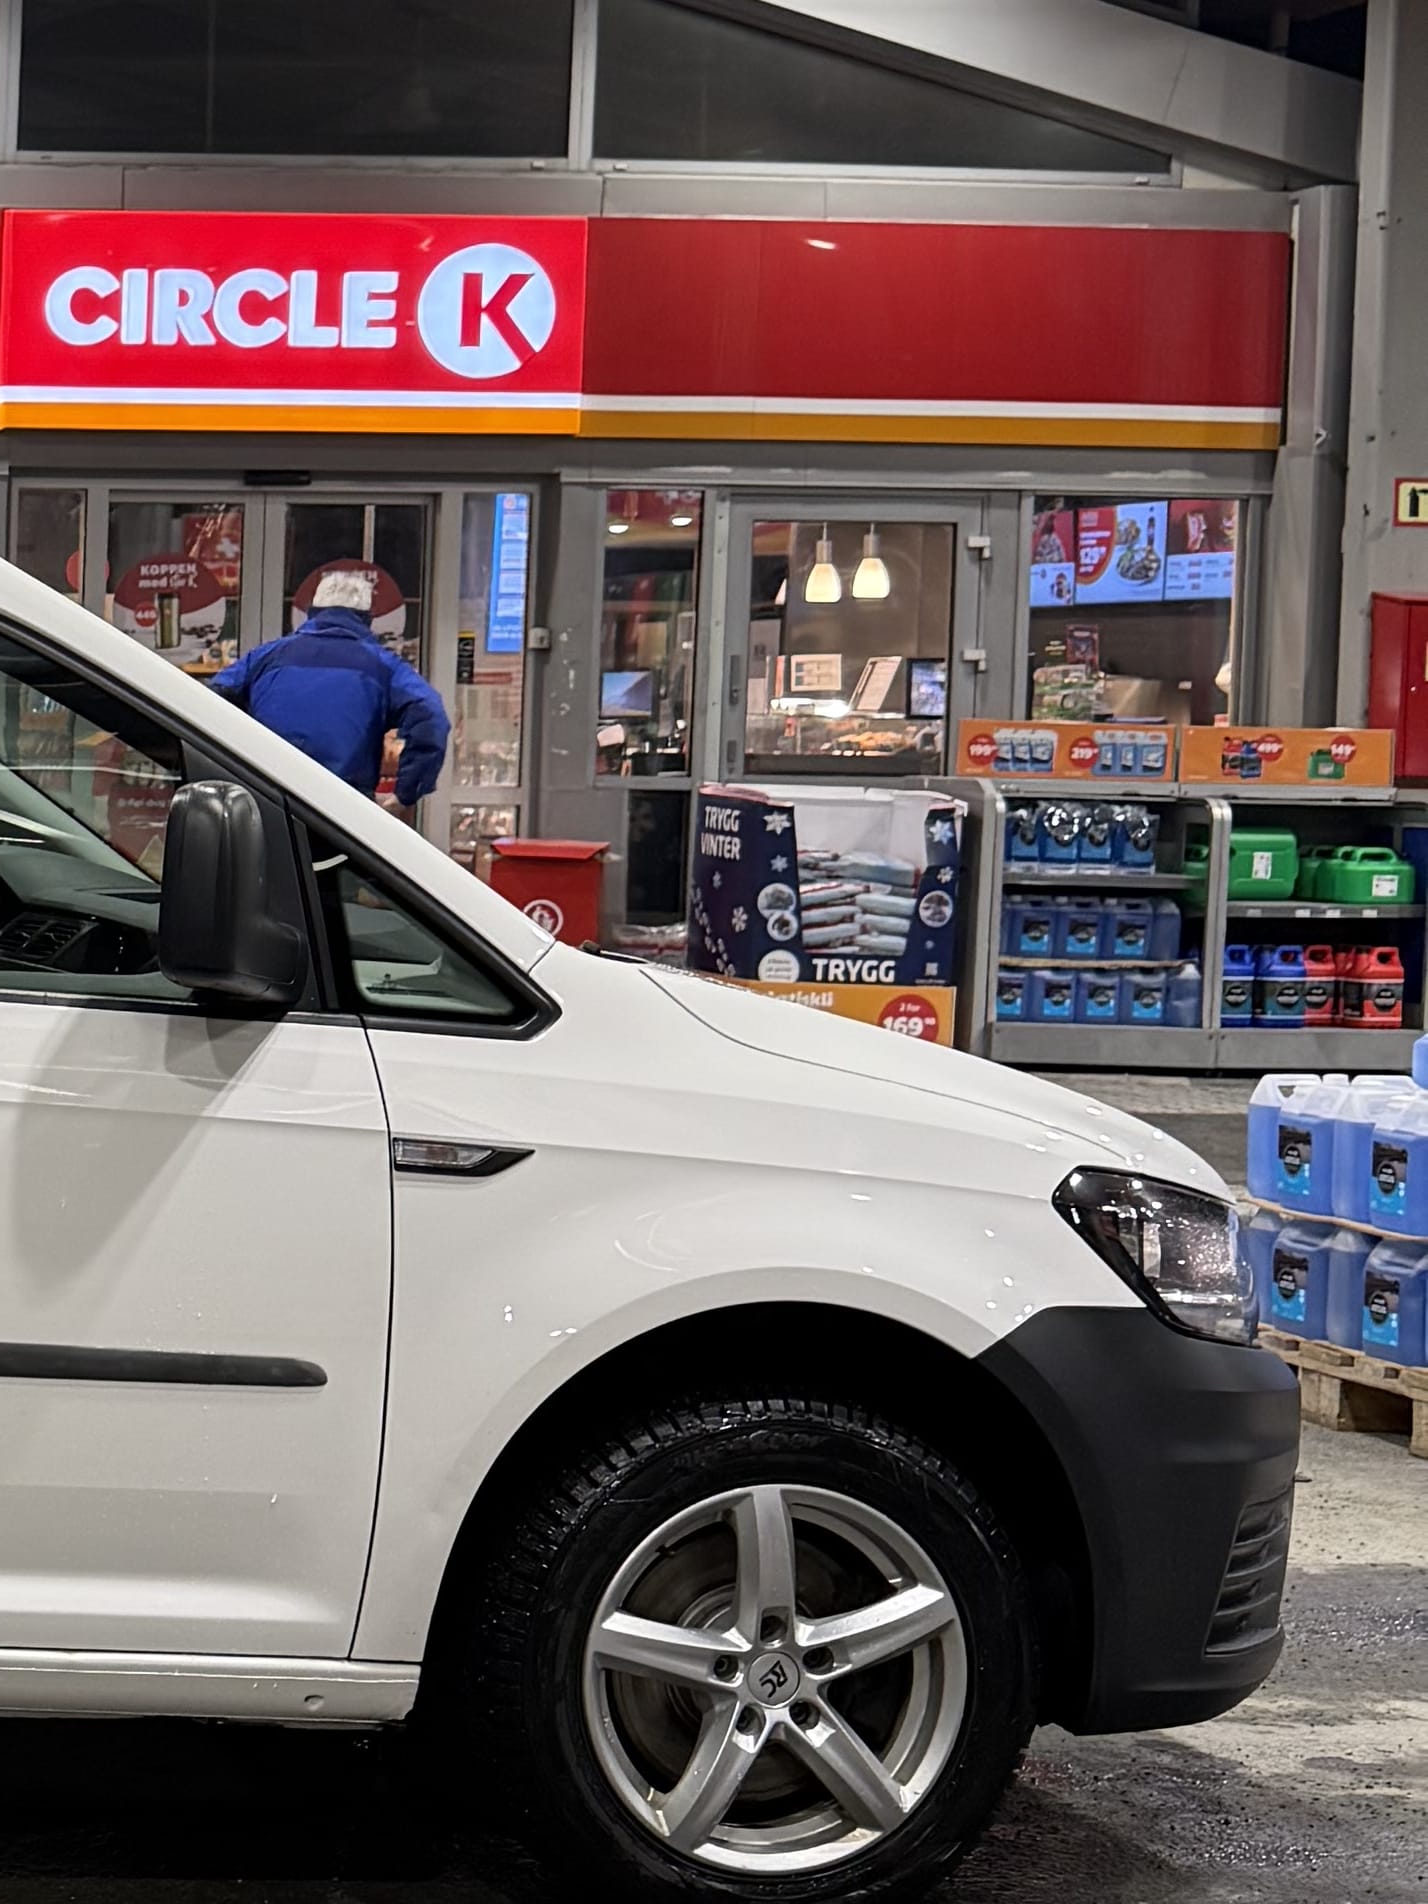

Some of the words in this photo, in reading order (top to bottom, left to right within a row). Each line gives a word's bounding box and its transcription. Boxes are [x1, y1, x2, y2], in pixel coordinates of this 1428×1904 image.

[44, 265, 400, 350] CIRCLE
[704, 805, 741, 832] TRYGG
[701, 833, 741, 860] VINTER
[812, 958, 896, 983] TRYGG
[760, 1661, 789, 1699] RC
